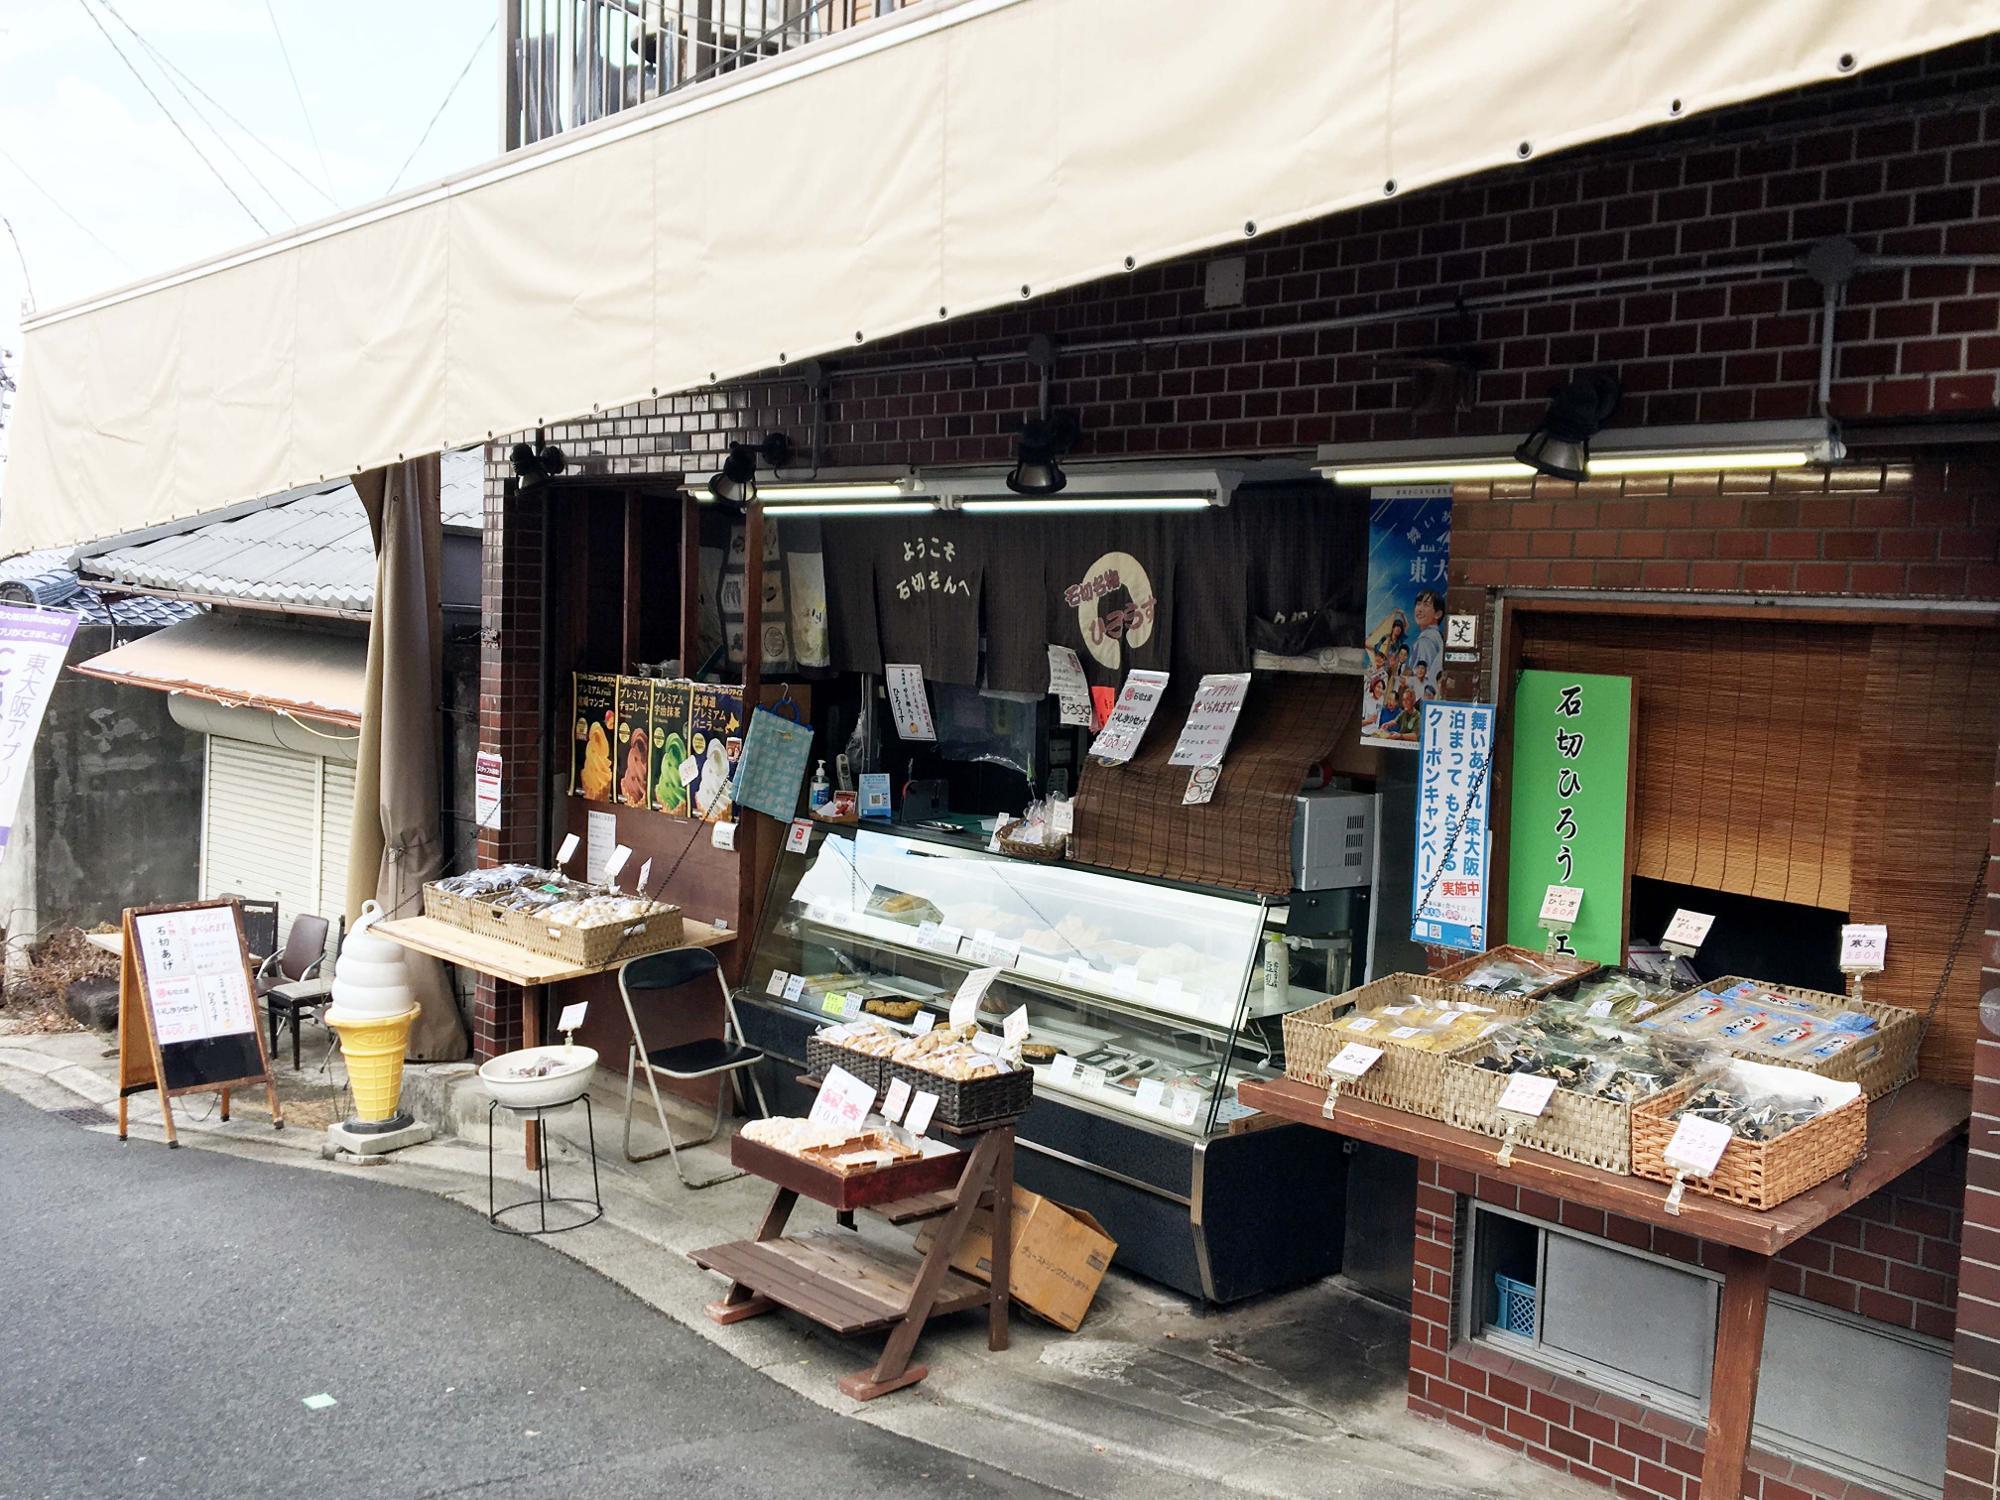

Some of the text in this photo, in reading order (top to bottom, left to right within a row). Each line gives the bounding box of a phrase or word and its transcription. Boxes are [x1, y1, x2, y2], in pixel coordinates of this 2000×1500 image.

[903, 537, 955, 562] ようこそ
[896, 571, 970, 600] 石切さんへ
[1063, 568, 1121, 607] 石切名物
[620, 687, 648, 701] プレミアム
[654, 692, 684, 705] プレミアム
[693, 708, 726, 721] プレミアム
[1447, 709, 1466, 787] 泊まって
[1421, 708, 1443, 890] クーポンキャンペーン
[1463, 817, 1481, 877] 東大阪
[1442, 881, 1480, 897] 実施中
[1850, 939, 1877, 949] 寒天
